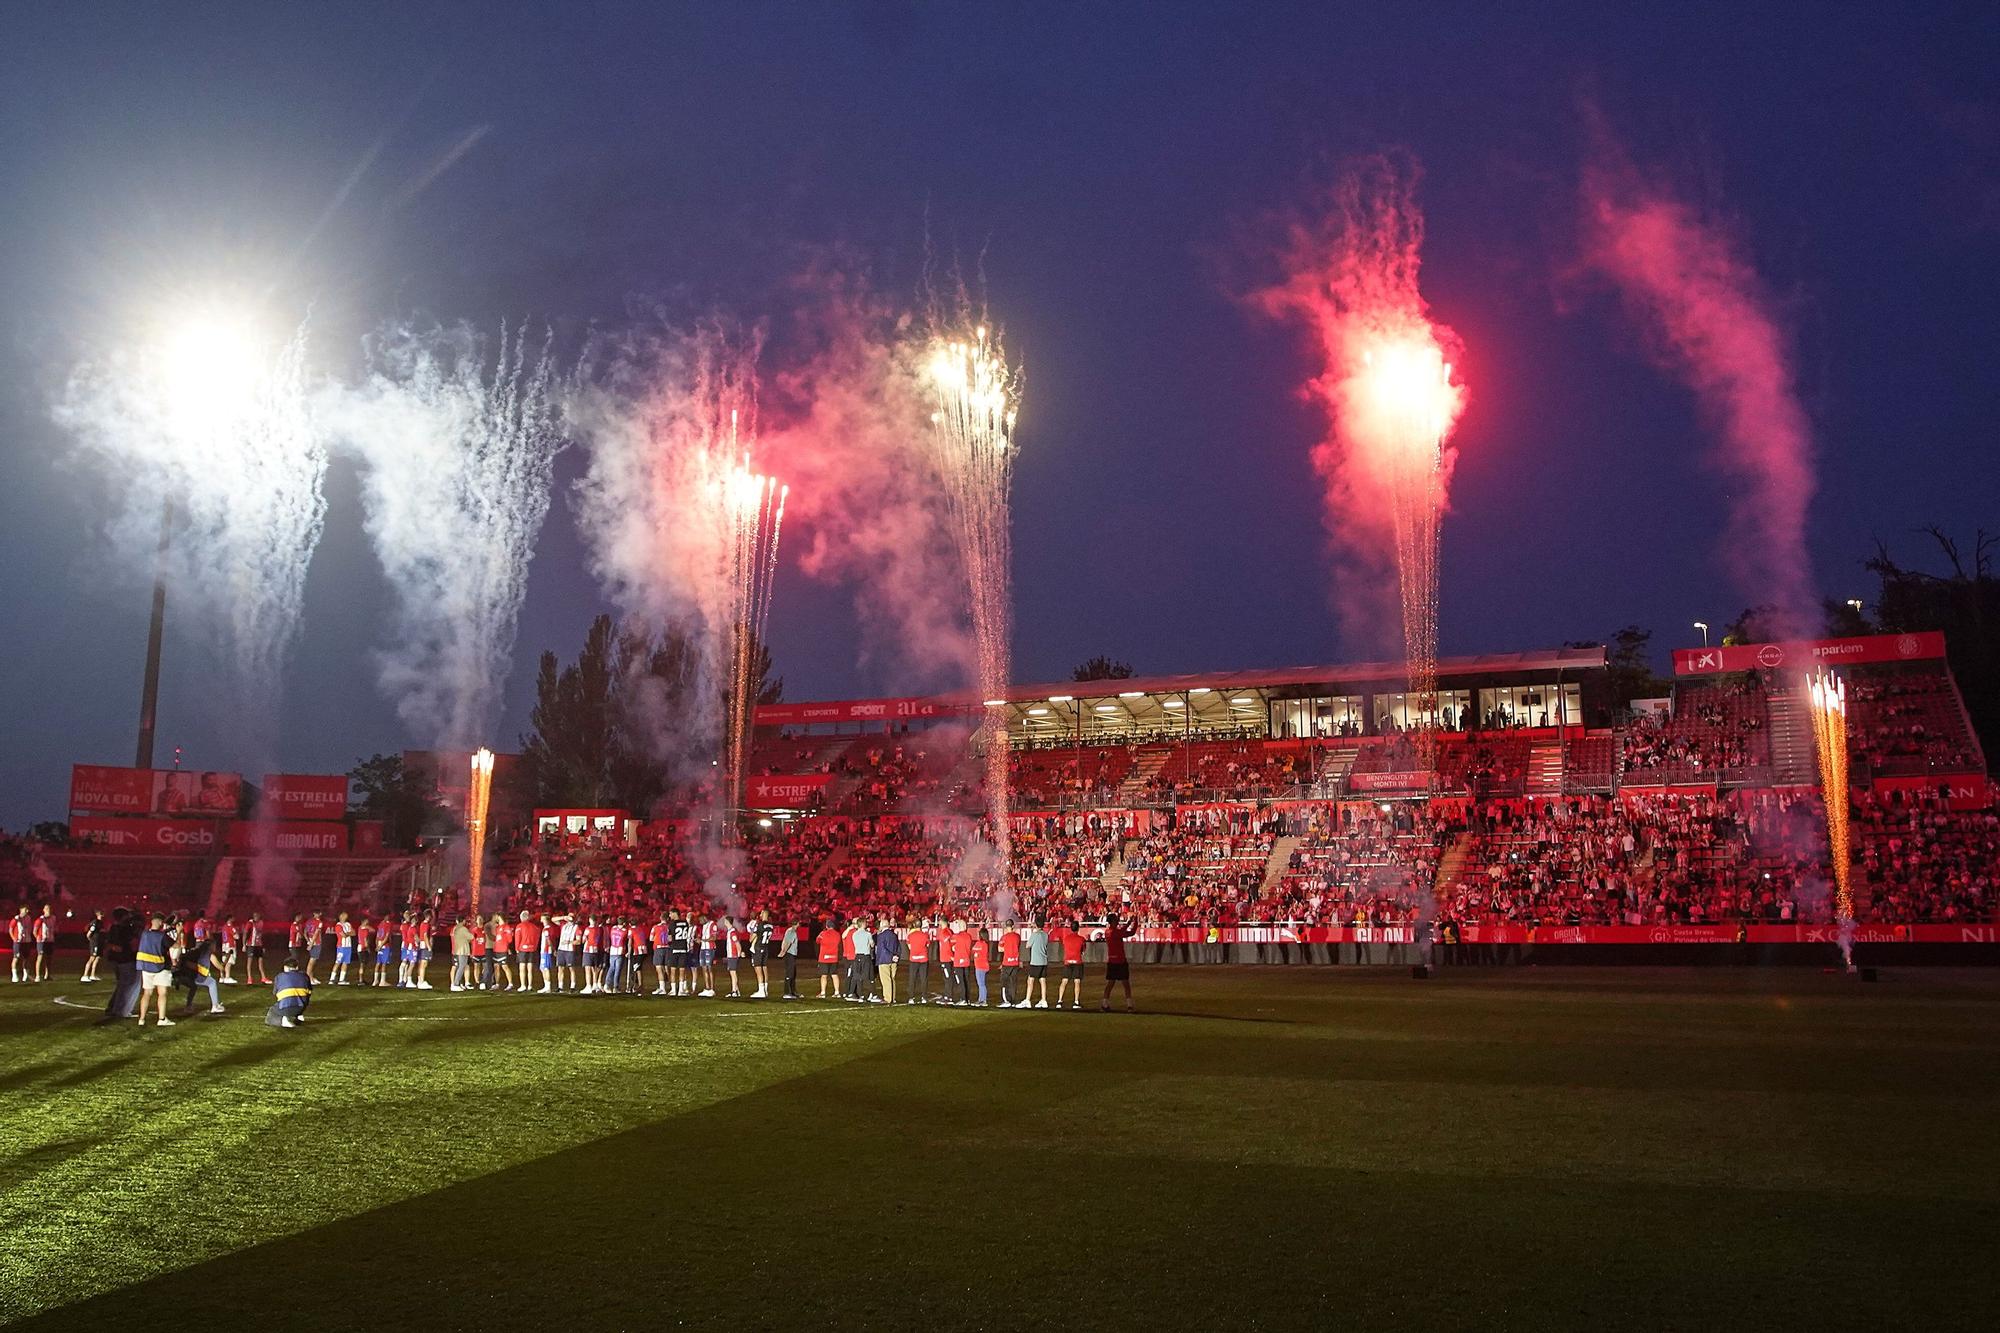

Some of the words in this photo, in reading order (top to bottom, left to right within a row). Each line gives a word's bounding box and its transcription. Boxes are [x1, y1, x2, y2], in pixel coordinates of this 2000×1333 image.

[1821, 644, 1863, 657] parlem
[851, 704, 887, 717] SPORT
[75, 791, 111, 805] NOVA
[113, 794, 139, 806] ERA
[285, 791, 344, 803] ESTRELLA
[156, 826, 214, 845] Gosb
[277, 833, 319, 849] GIRONA
[322, 834, 337, 849] FC
[674, 926, 688, 941] 26
[1356, 927, 1415, 943] GIRONA
